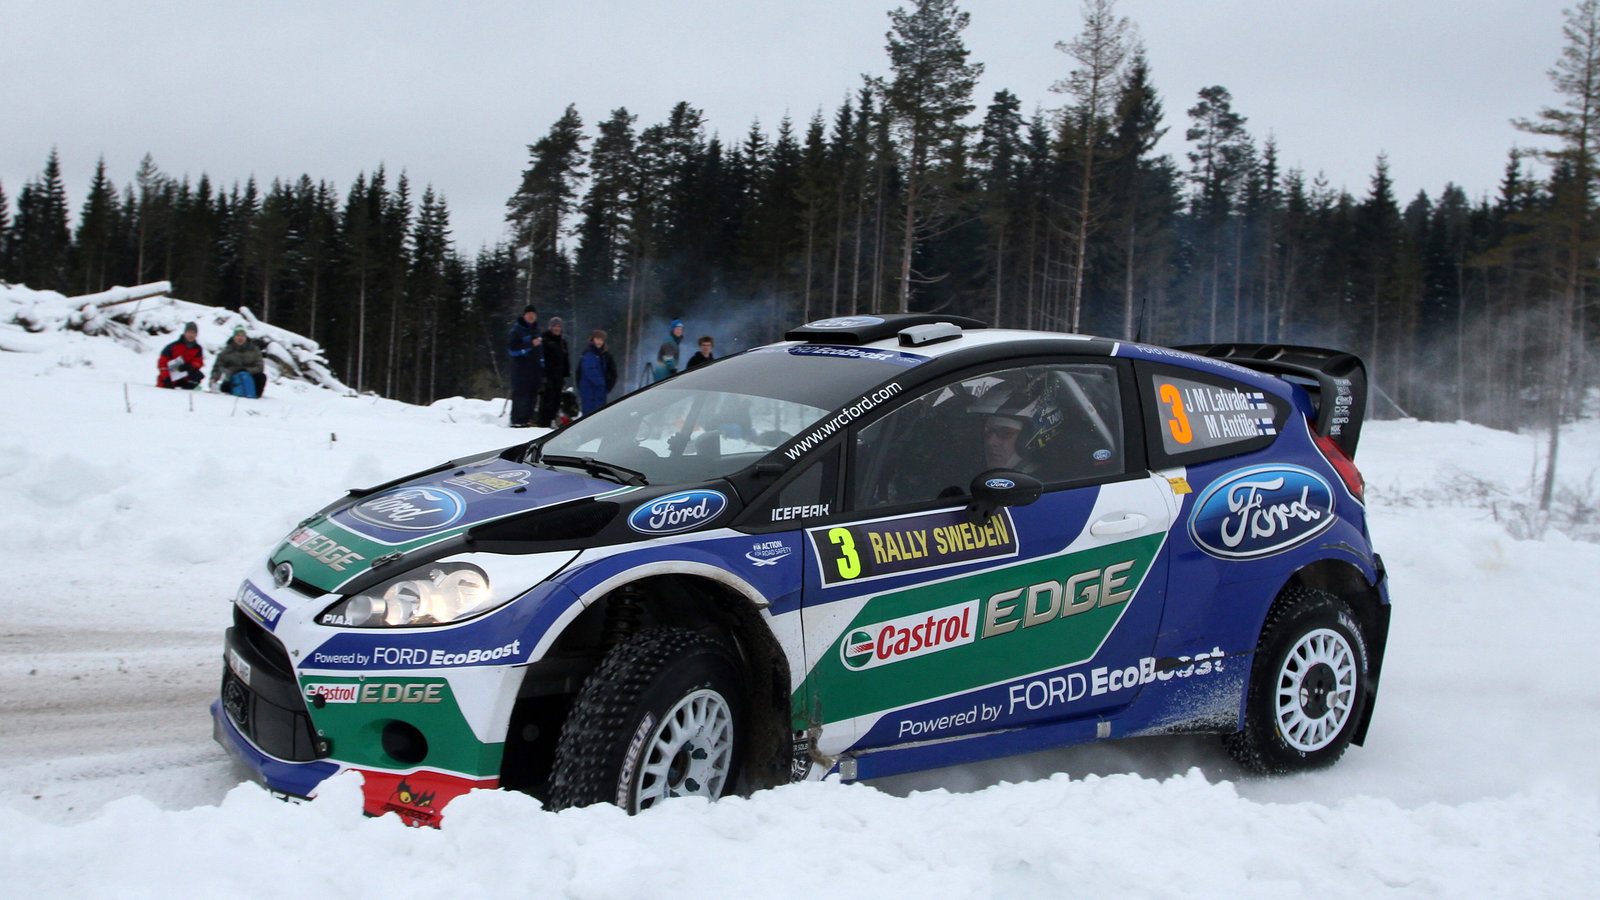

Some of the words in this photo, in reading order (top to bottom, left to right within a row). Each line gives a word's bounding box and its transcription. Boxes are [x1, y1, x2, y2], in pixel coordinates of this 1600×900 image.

[812, 347, 894, 360] EcoBoost
[1160, 384, 1193, 444] 3
[1185, 388, 1194, 413] J
[1193, 388, 1209, 412] M
[1206, 387, 1250, 412] Latvala
[784, 382, 903, 460] www.wrcford.com
[1204, 414, 1221, 438] M
[1221, 413, 1258, 438] Anttila
[361, 490, 443, 521] Ford
[649, 496, 710, 529] Ford
[771, 504, 829, 521] ICEPEAK
[1221, 477, 1320, 547] Ford
[300, 535, 366, 572] EDGE
[762, 540, 782, 550] ACTION
[829, 527, 861, 579] 3
[868, 530, 929, 564] RALLY
[933, 513, 1010, 555] SWEDEN
[242, 588, 280, 622] MICHELIN
[322, 614, 353, 625] PIAA
[876, 607, 970, 660] Castrol
[982, 558, 1137, 639] EDGE
[314, 652, 353, 664] Powered
[356, 653, 369, 665] by
[373, 648, 427, 665] FORD
[429, 640, 520, 665] EcoBoost
[317, 685, 355, 701] Castrol
[359, 683, 446, 704] EDGE
[898, 704, 977, 738] Powered
[981, 703, 1002, 722] by
[1008, 672, 1087, 714] FORD
